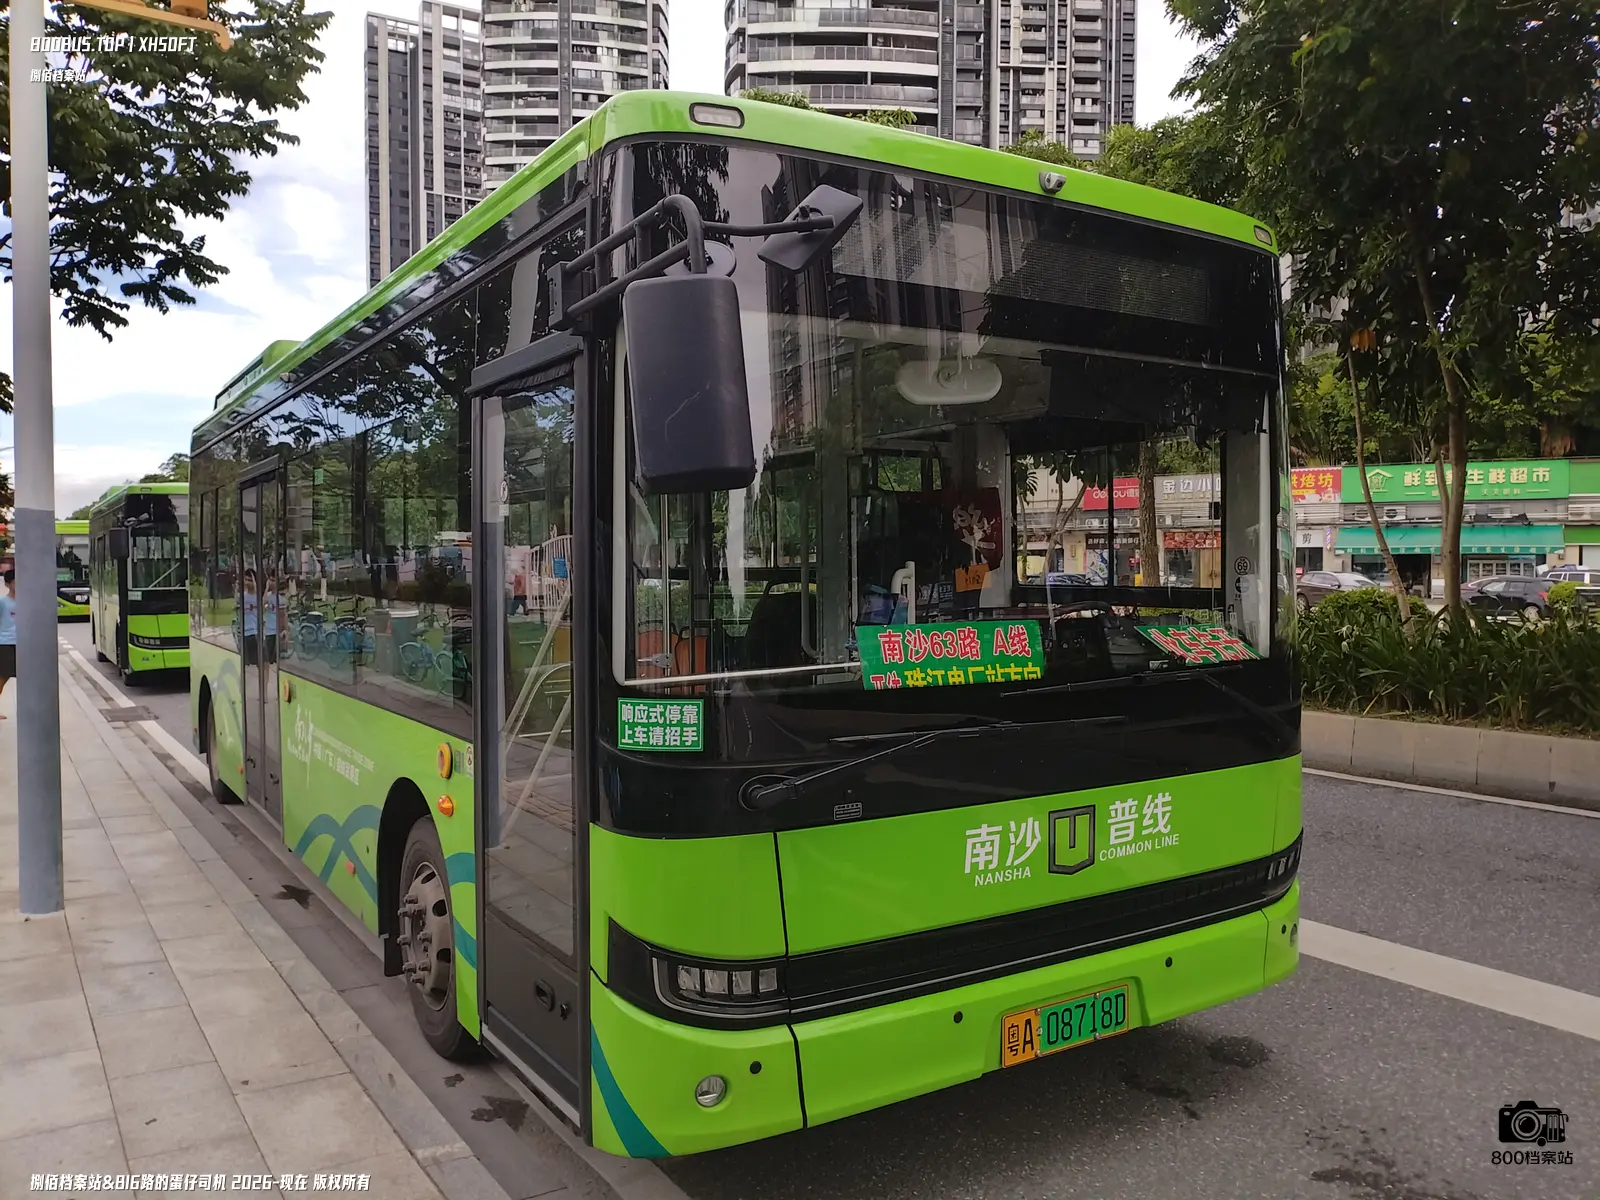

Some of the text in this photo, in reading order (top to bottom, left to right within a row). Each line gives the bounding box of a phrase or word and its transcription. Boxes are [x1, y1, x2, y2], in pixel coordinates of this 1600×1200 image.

[878, 624, 1032, 663] 南沙63路 A线
[621, 703, 699, 725] 响应式停靠
[621, 724, 698, 746] 上车请招手
[1107, 792, 1172, 845] 普线
[964, 816, 1042, 874] 南沙
[1100, 833, 1180, 862] COMMON LINE
[974, 866, 1032, 887] NANSHA
